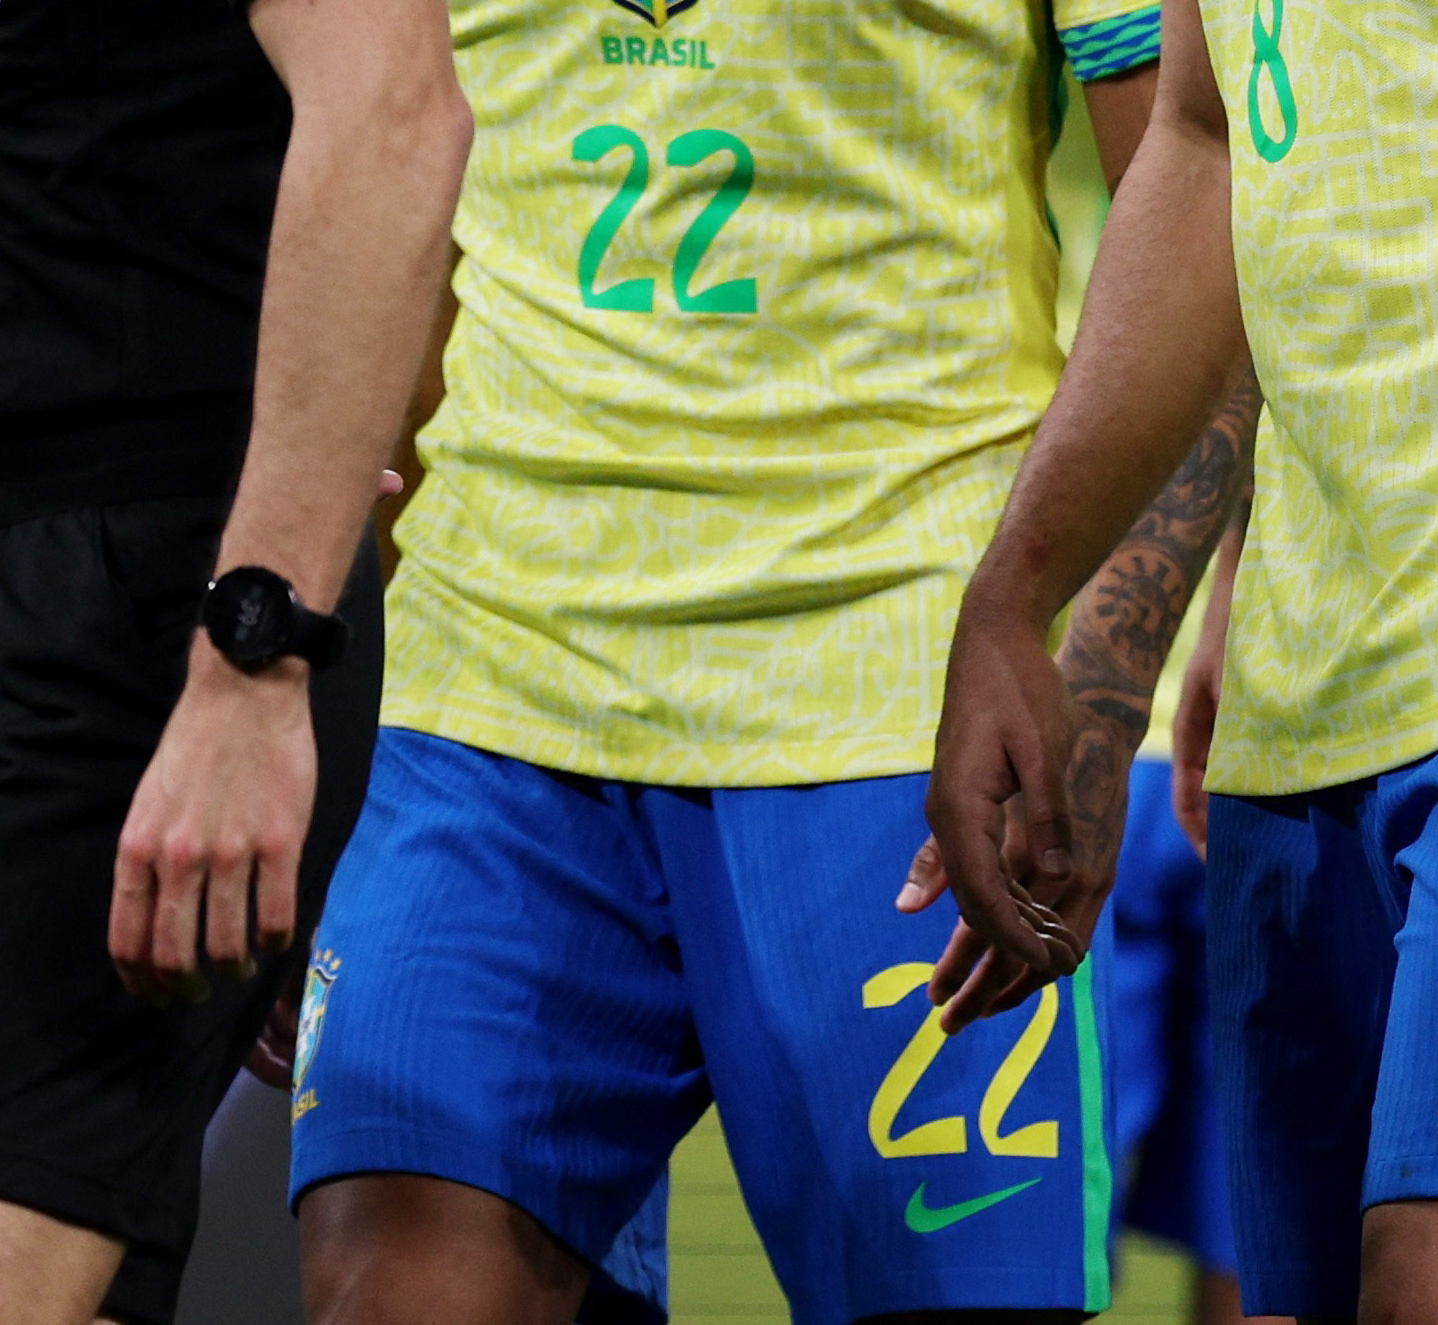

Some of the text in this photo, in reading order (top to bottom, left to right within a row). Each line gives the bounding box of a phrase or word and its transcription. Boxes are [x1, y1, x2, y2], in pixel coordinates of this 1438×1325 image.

[601, 36, 716, 70] BRASIL
[571, 124, 758, 314] 22
[862, 962, 1059, 1158] 22
